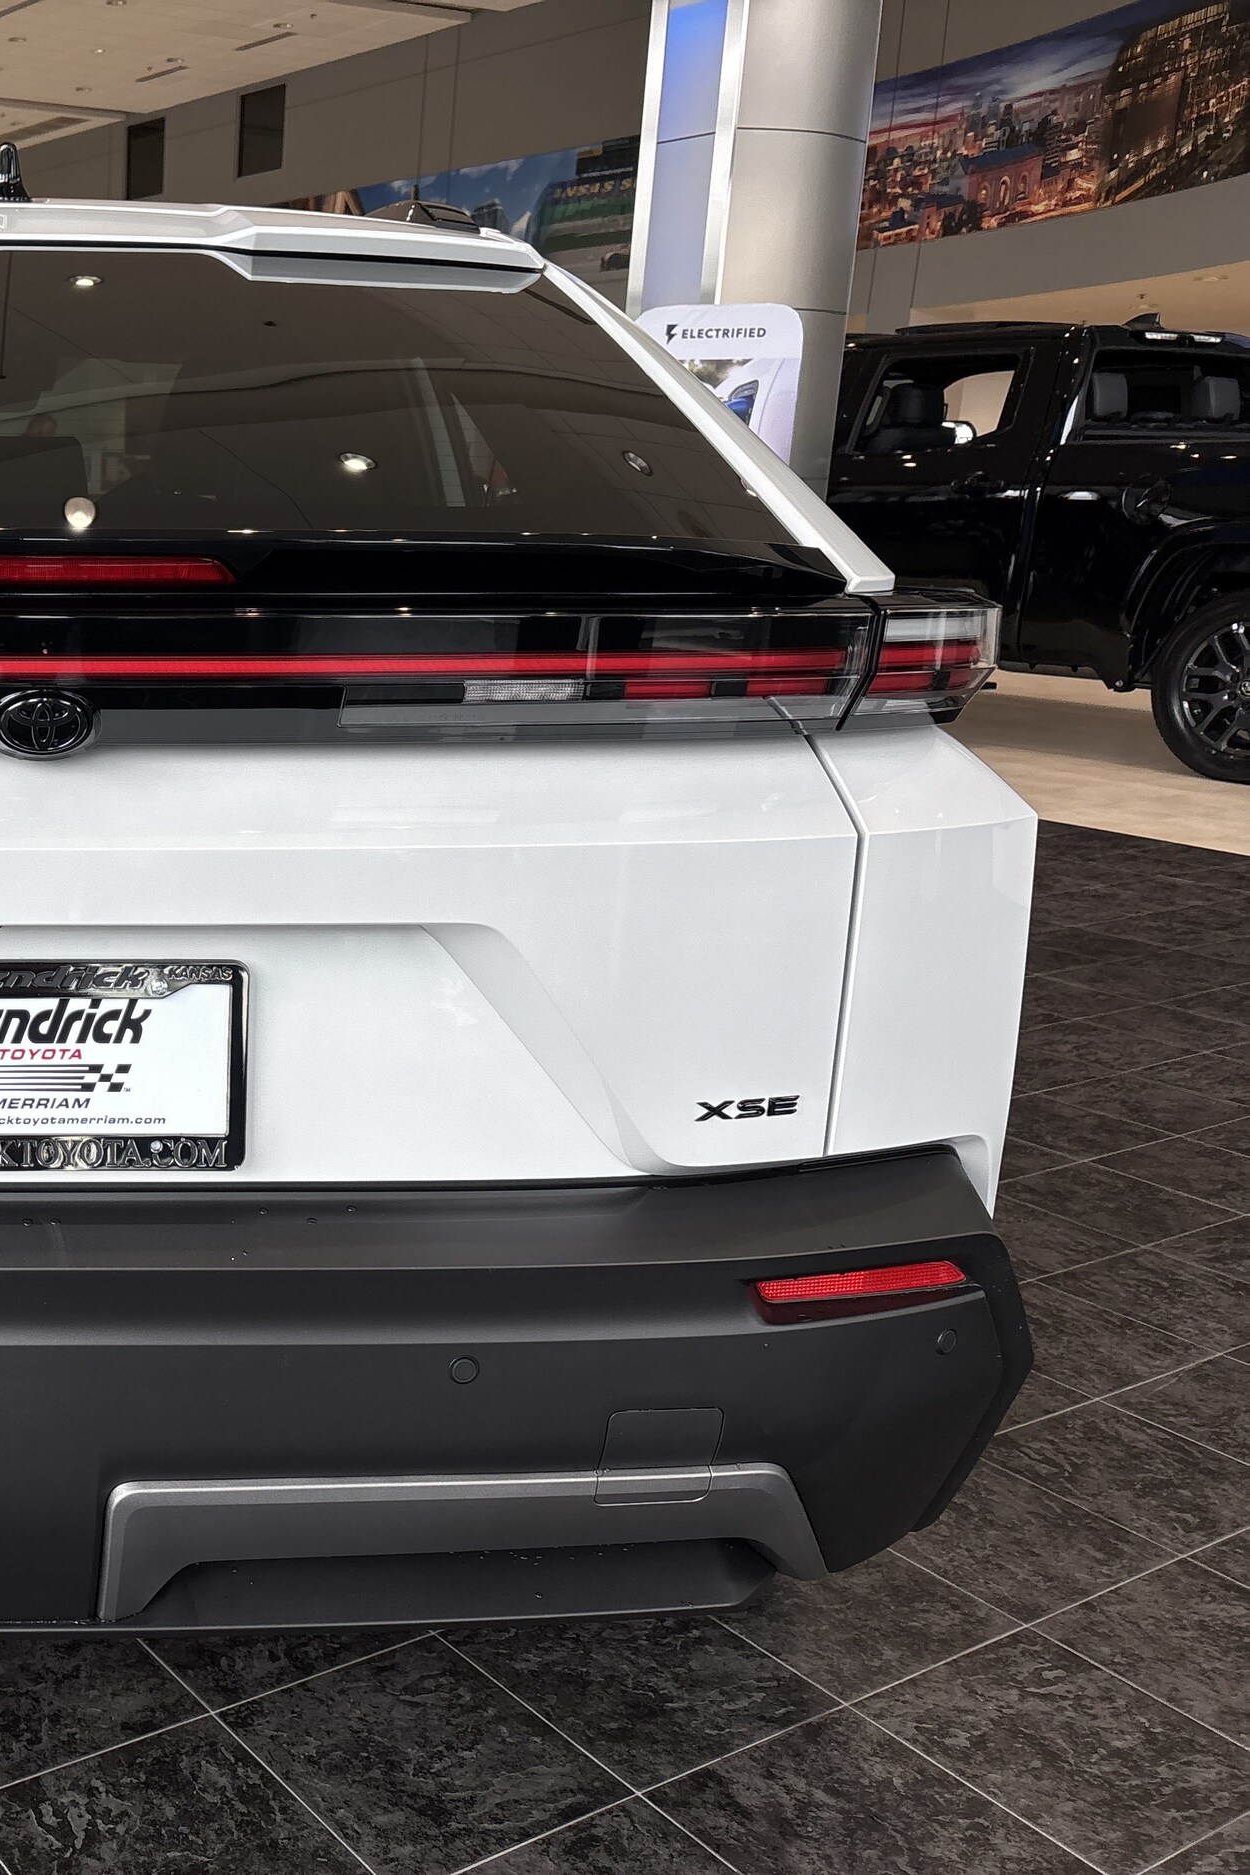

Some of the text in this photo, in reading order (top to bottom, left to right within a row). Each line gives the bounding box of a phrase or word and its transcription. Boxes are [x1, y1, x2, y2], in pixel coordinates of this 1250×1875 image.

[681, 327, 767, 339] ELECTRIFIED
[168, 965, 234, 980] KANSAS
[694, 1095, 800, 1121] XSE
